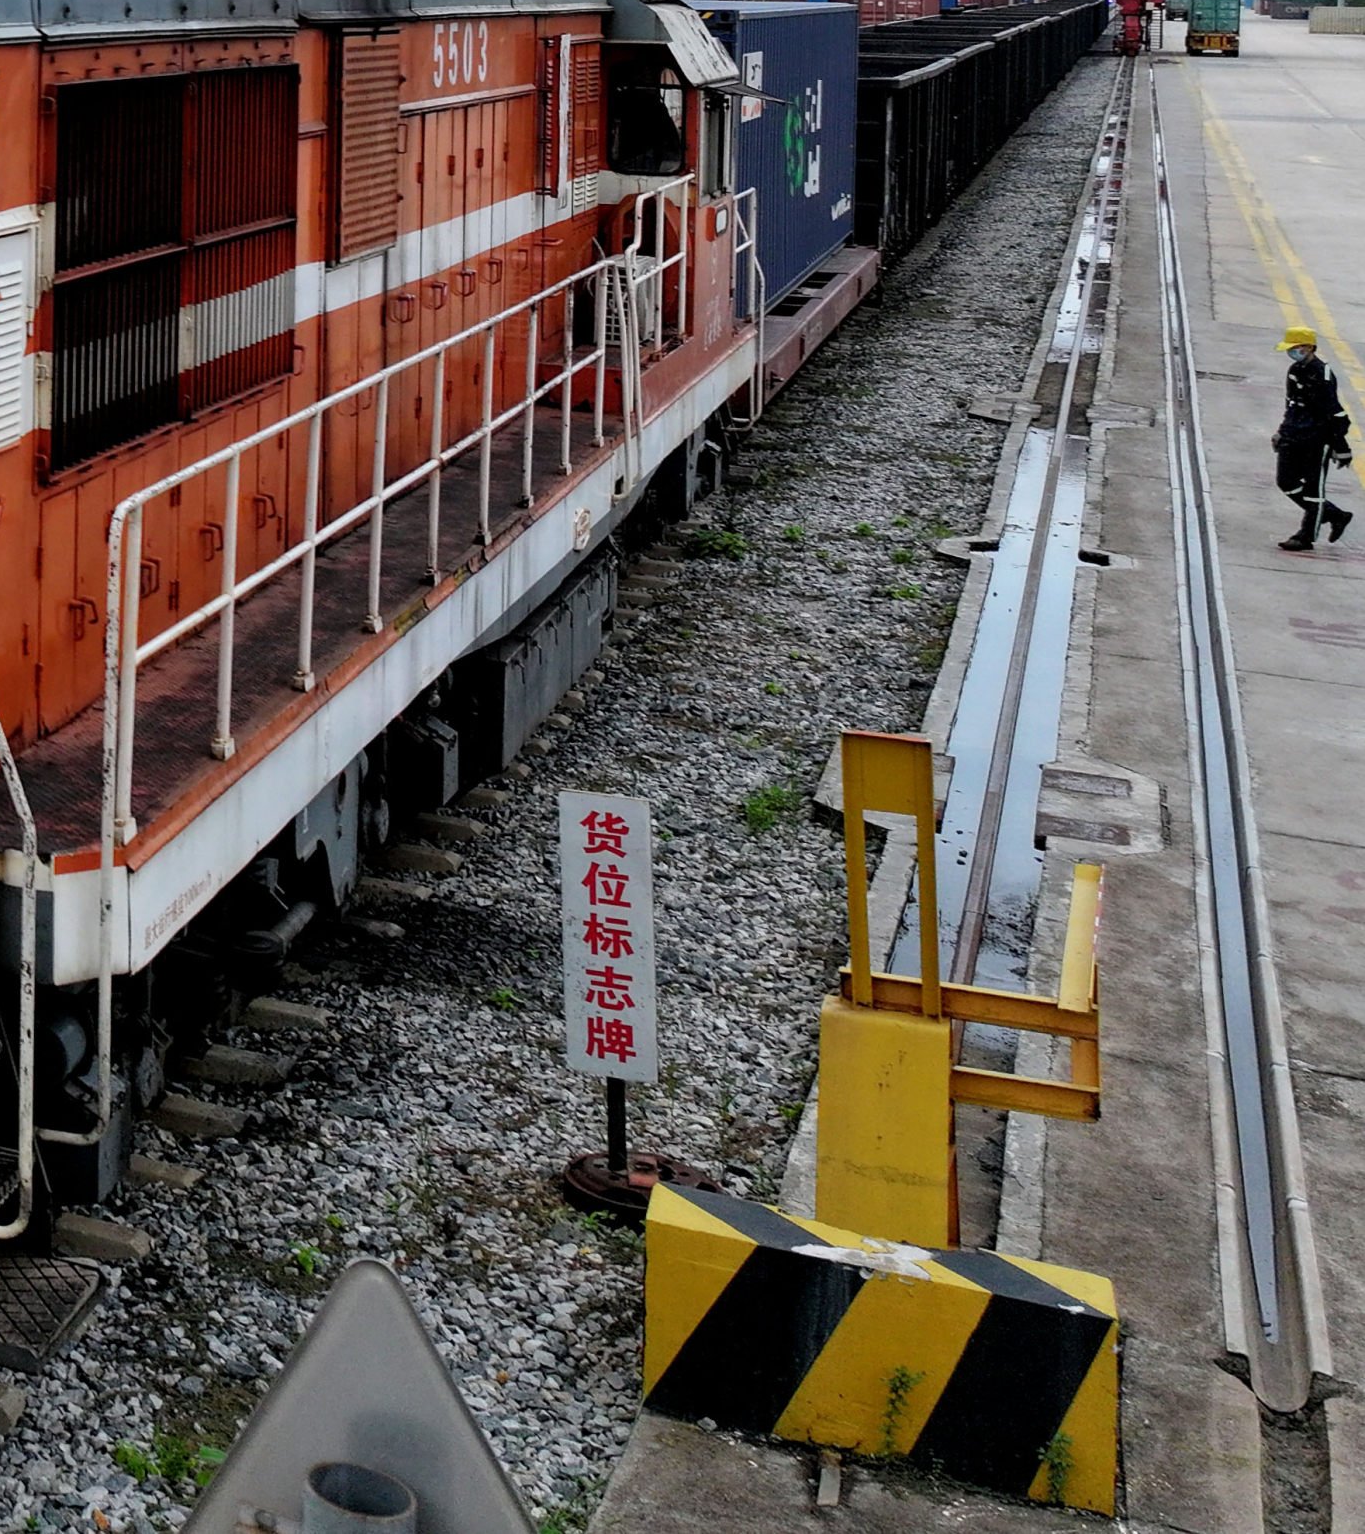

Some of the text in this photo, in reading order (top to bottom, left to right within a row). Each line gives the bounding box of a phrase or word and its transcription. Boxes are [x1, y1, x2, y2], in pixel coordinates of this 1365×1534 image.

[433, 21, 488, 88] 5503
[580, 810, 637, 1064] 货位标志牌
